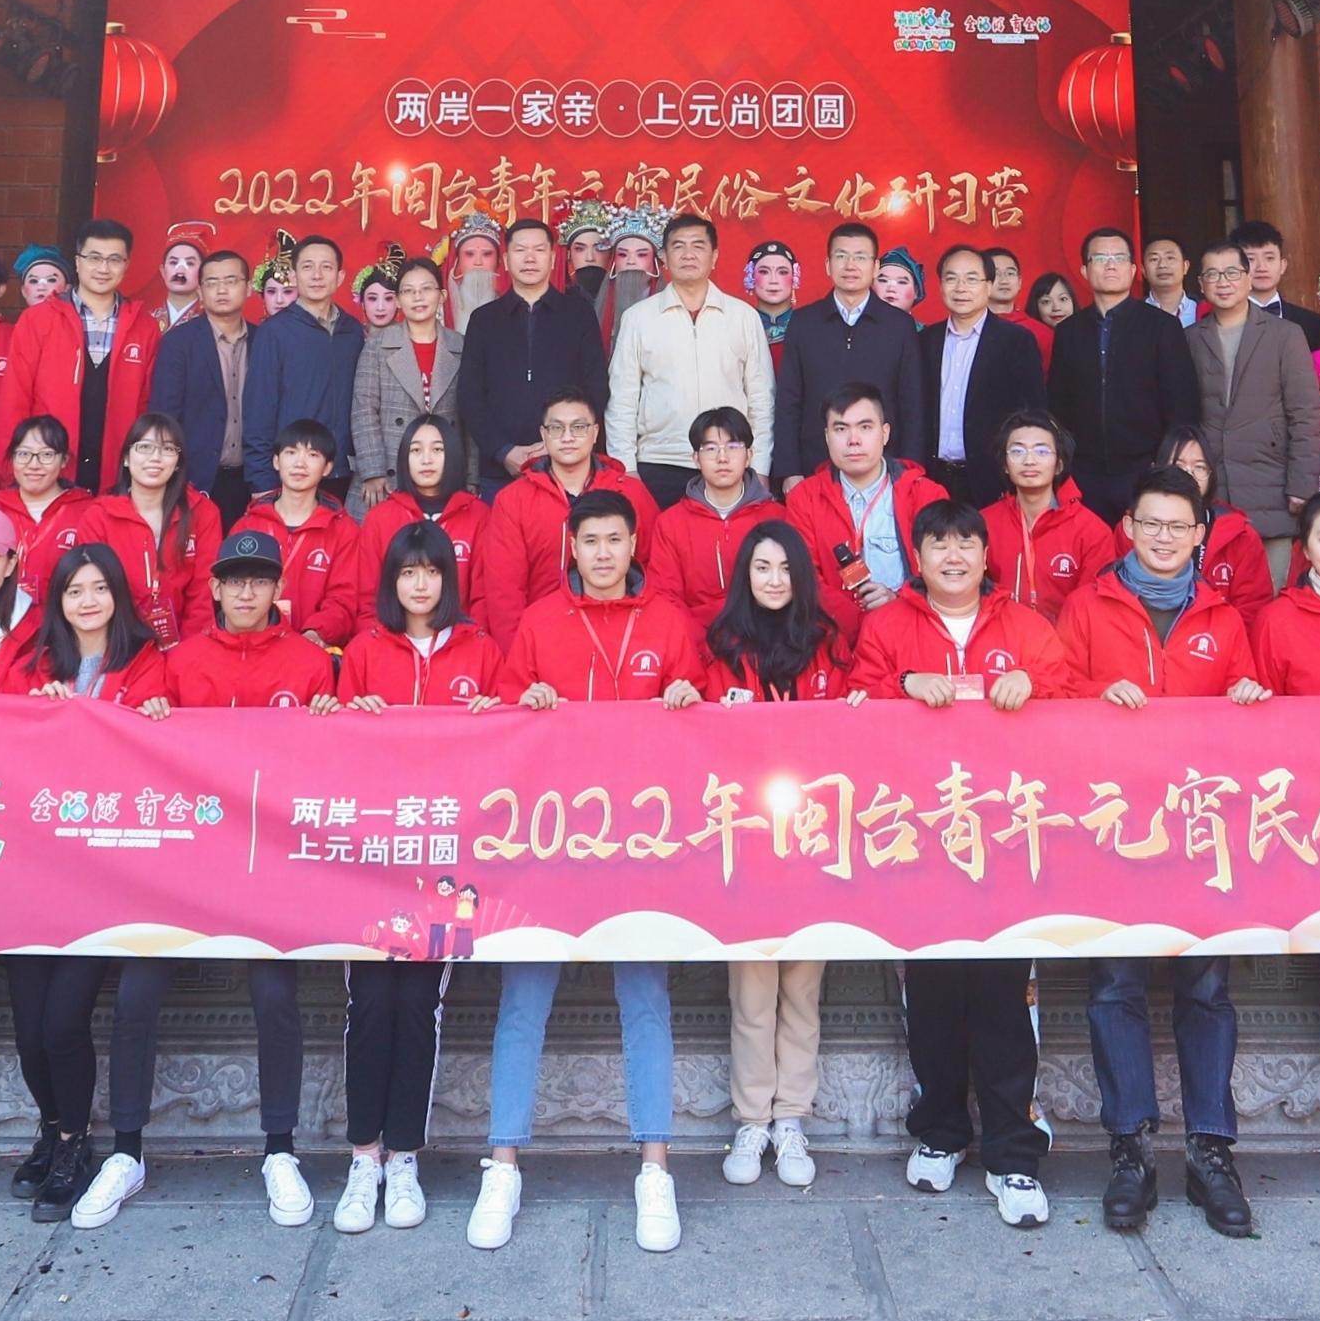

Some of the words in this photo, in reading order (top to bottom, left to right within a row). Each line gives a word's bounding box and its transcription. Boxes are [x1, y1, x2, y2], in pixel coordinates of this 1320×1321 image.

[291, 795, 461, 829] 两岸一家亲
[288, 833, 459, 867] 上元尚团圆
